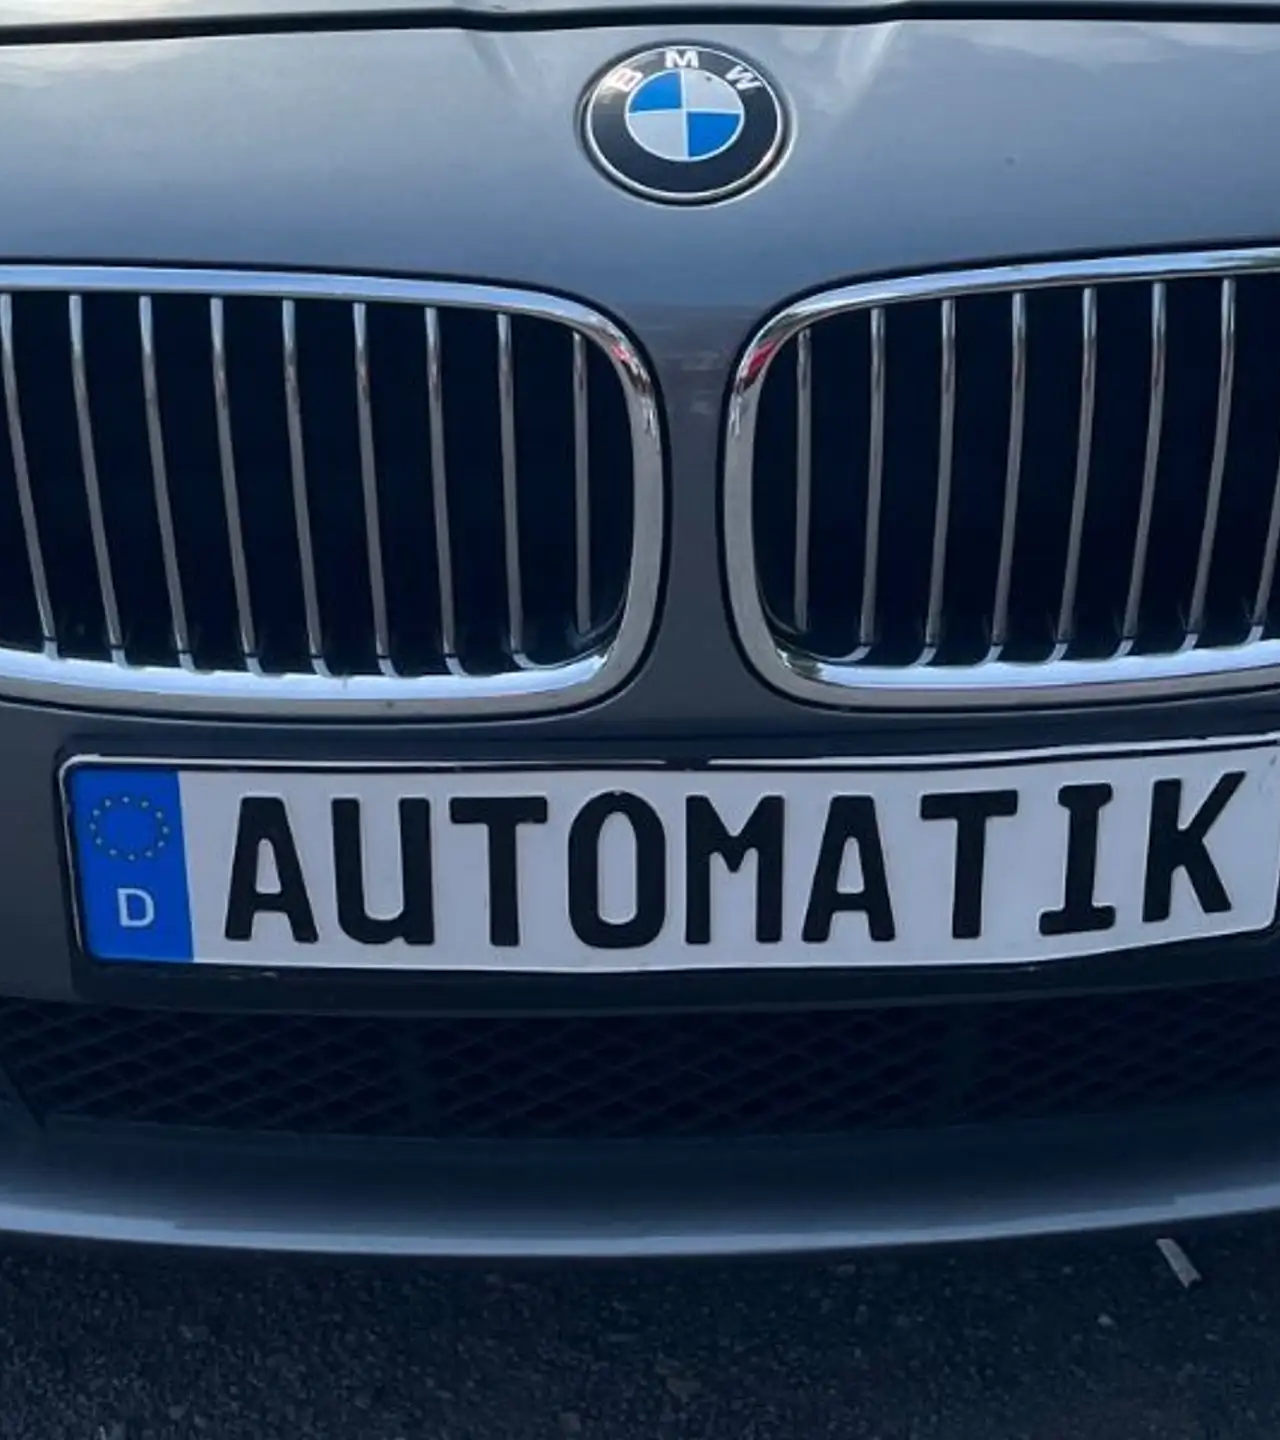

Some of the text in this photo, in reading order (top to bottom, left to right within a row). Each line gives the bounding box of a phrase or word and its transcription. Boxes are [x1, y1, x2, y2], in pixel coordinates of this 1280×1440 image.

[604, 48, 763, 93] BMW
[224, 771, 1247, 950] AUTOMATIK
[117, 887, 155, 928] D
